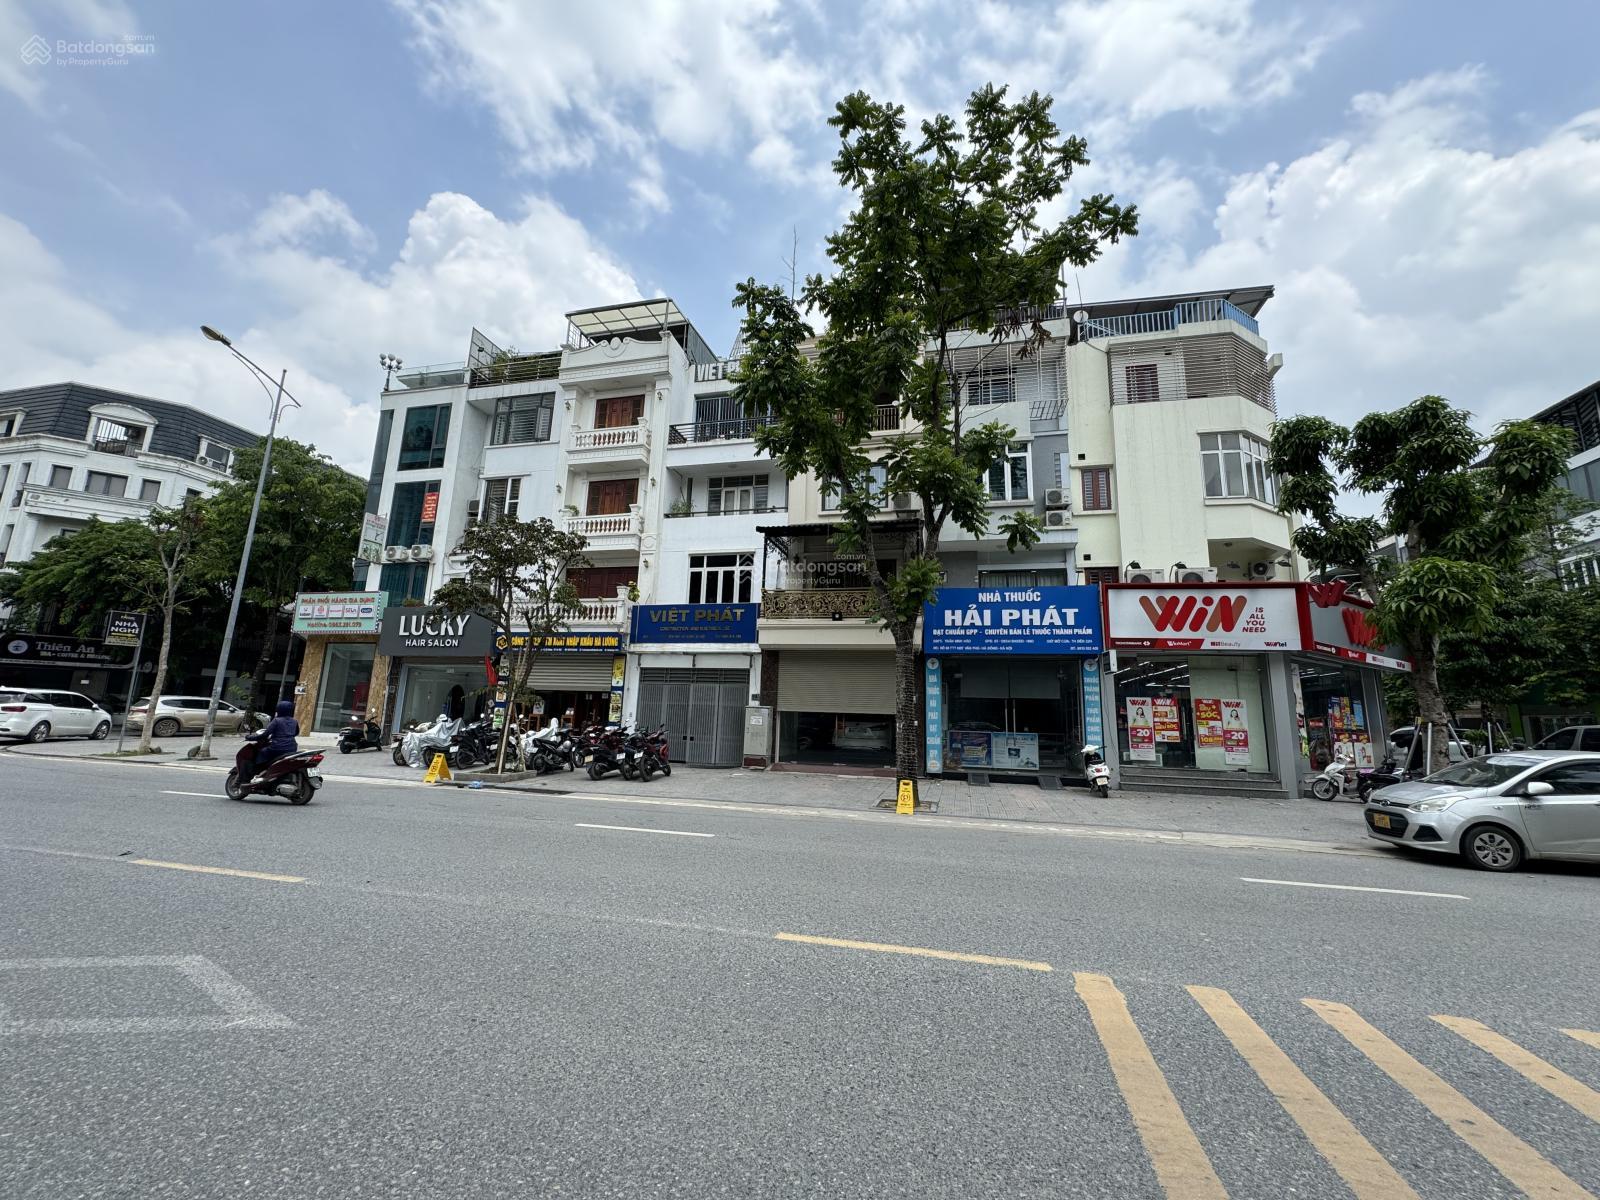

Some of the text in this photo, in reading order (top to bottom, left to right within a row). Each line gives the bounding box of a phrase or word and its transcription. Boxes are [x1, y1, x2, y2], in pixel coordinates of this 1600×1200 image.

[978, 588, 1041, 602] NHÀ THUỐC
[650, 606, 745, 624] VIỆT PHÁT
[944, 603, 1079, 627] HẢI PHÁT
[398, 614, 471, 637] LUCKY
[76, 644, 95, 653] An
[405, 638, 459, 647] HAIR SALON
